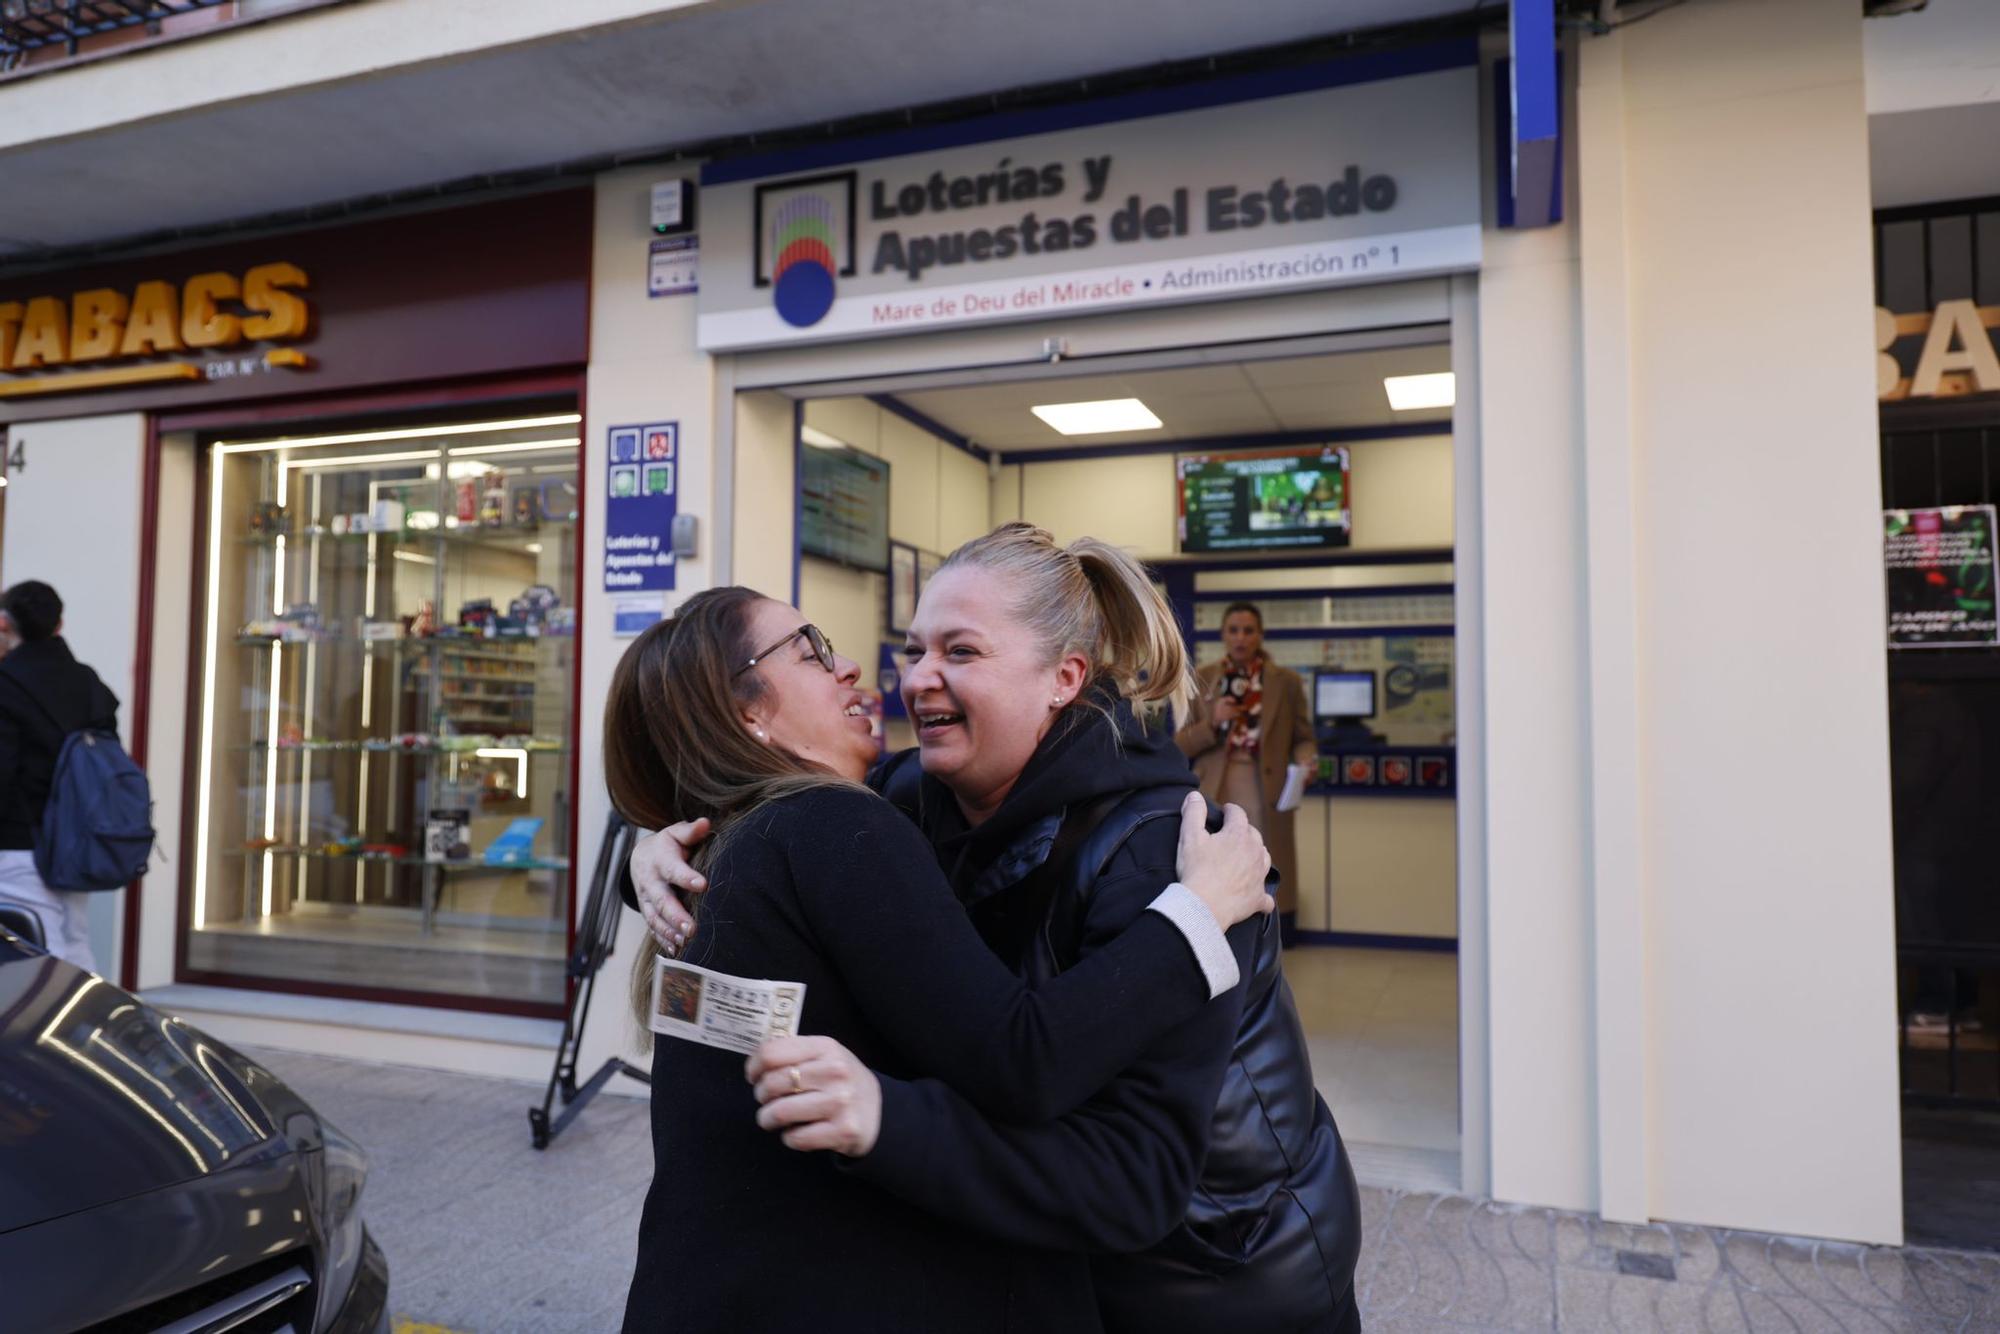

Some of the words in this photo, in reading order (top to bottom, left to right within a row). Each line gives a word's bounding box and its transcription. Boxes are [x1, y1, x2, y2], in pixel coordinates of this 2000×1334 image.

[871, 157, 1065, 220] Loterías
[1083, 154, 1112, 205] y
[872, 212, 1097, 281] Apuestas
[1110, 186, 1189, 243] del
[1206, 164, 1397, 232] Estado
[872, 303, 925, 324] Mare
[931, 297, 957, 317] de
[964, 293, 1005, 313] Deu
[1013, 288, 1045, 308] del
[1053, 276, 1135, 303] Miracle
[1161, 250, 1343, 290] Administración
[1352, 246, 1380, 269] nº
[1390, 245, 1399, 265] 1
